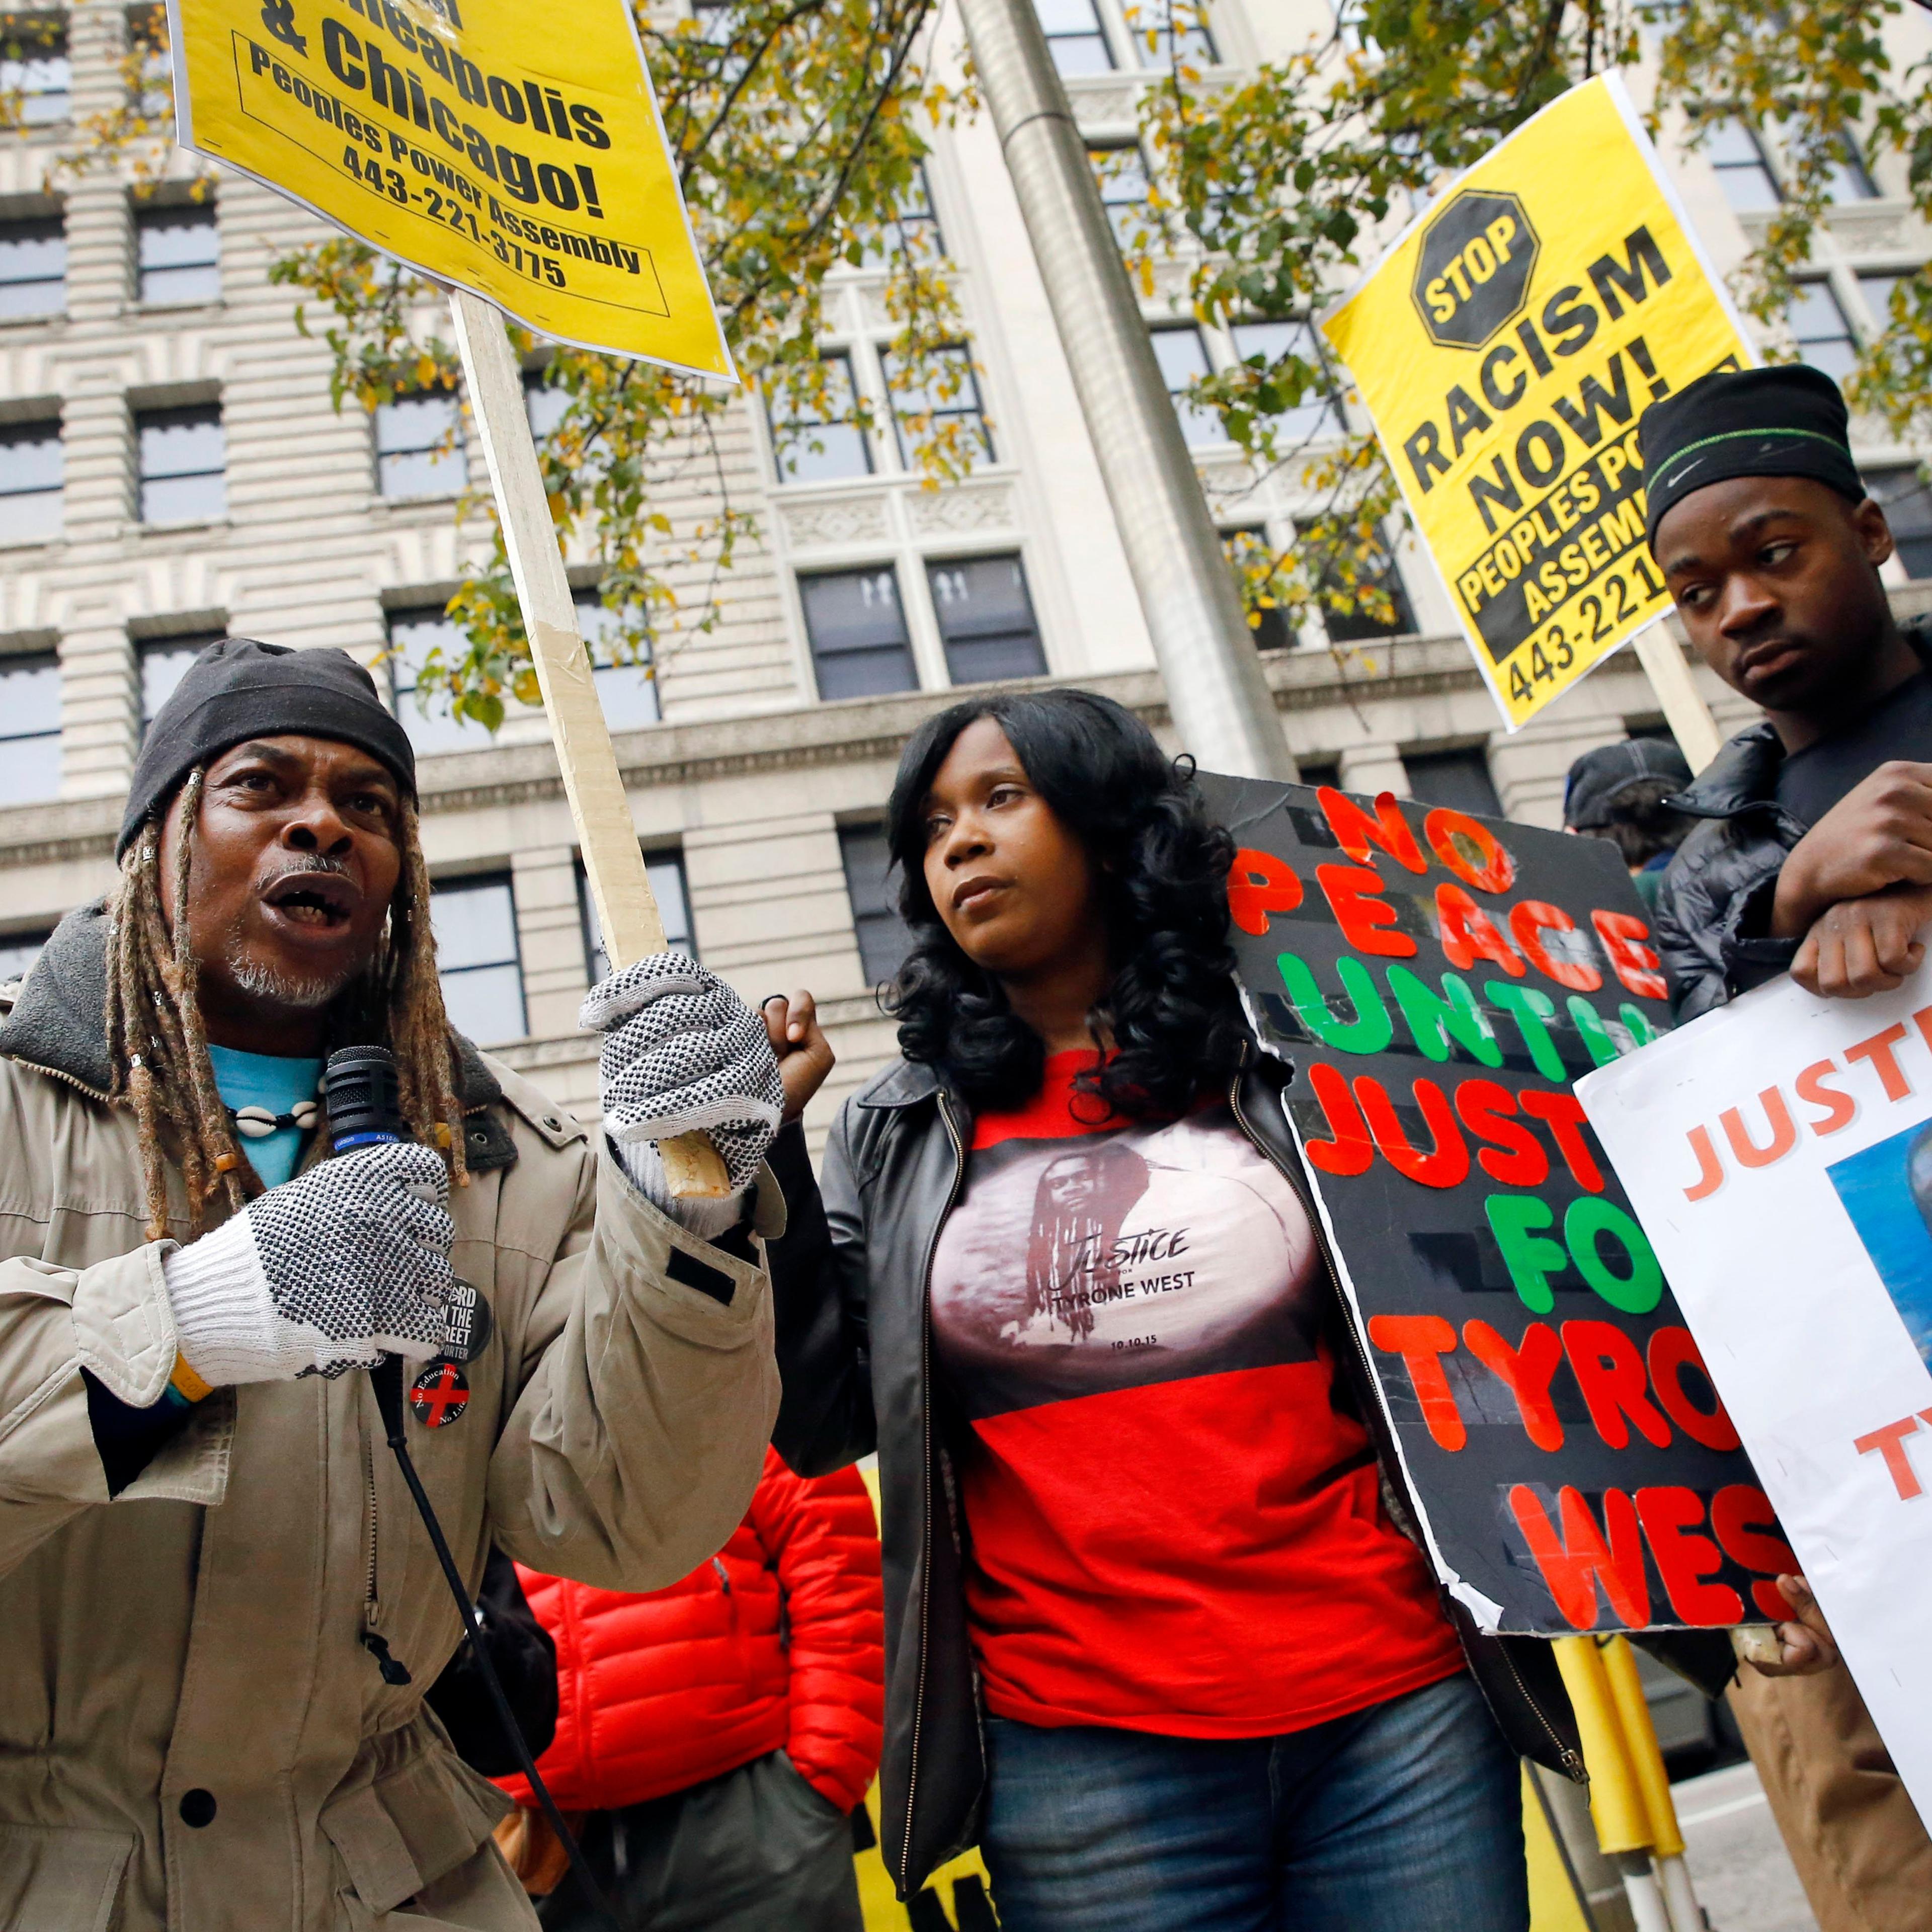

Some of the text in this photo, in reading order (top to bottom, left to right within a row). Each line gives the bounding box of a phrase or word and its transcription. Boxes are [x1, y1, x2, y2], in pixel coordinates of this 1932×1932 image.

[249, 39, 640, 274] Peoples Power Assembly
[261, 0, 604, 219] & Chicago!
[343, 145, 567, 288] 443-221-3775
[1424, 214, 1516, 325] STOP
[1403, 223, 1673, 495] RACISM
[1466, 336, 1671, 539] NOW!
[1459, 470, 1601, 615] PEOPLES
[1316, 785, 1516, 895] NO
[1227, 847, 1669, 1000] PEACE
[1304, 1063, 1605, 1194] JUST
[451, 1306, 474, 1329] THE
[1052, 1271, 1195, 1312] TYRONE WEST
[1485, 1194, 1663, 1314] FO
[415, 1368, 459, 1409] No Education
[1111, 1334, 1157, 1351] 10.10.15
[1367, 1315, 1742, 1453] TYRO
[439, 1416, 452, 1424] No
[1508, 1484, 1804, 1631] WES
